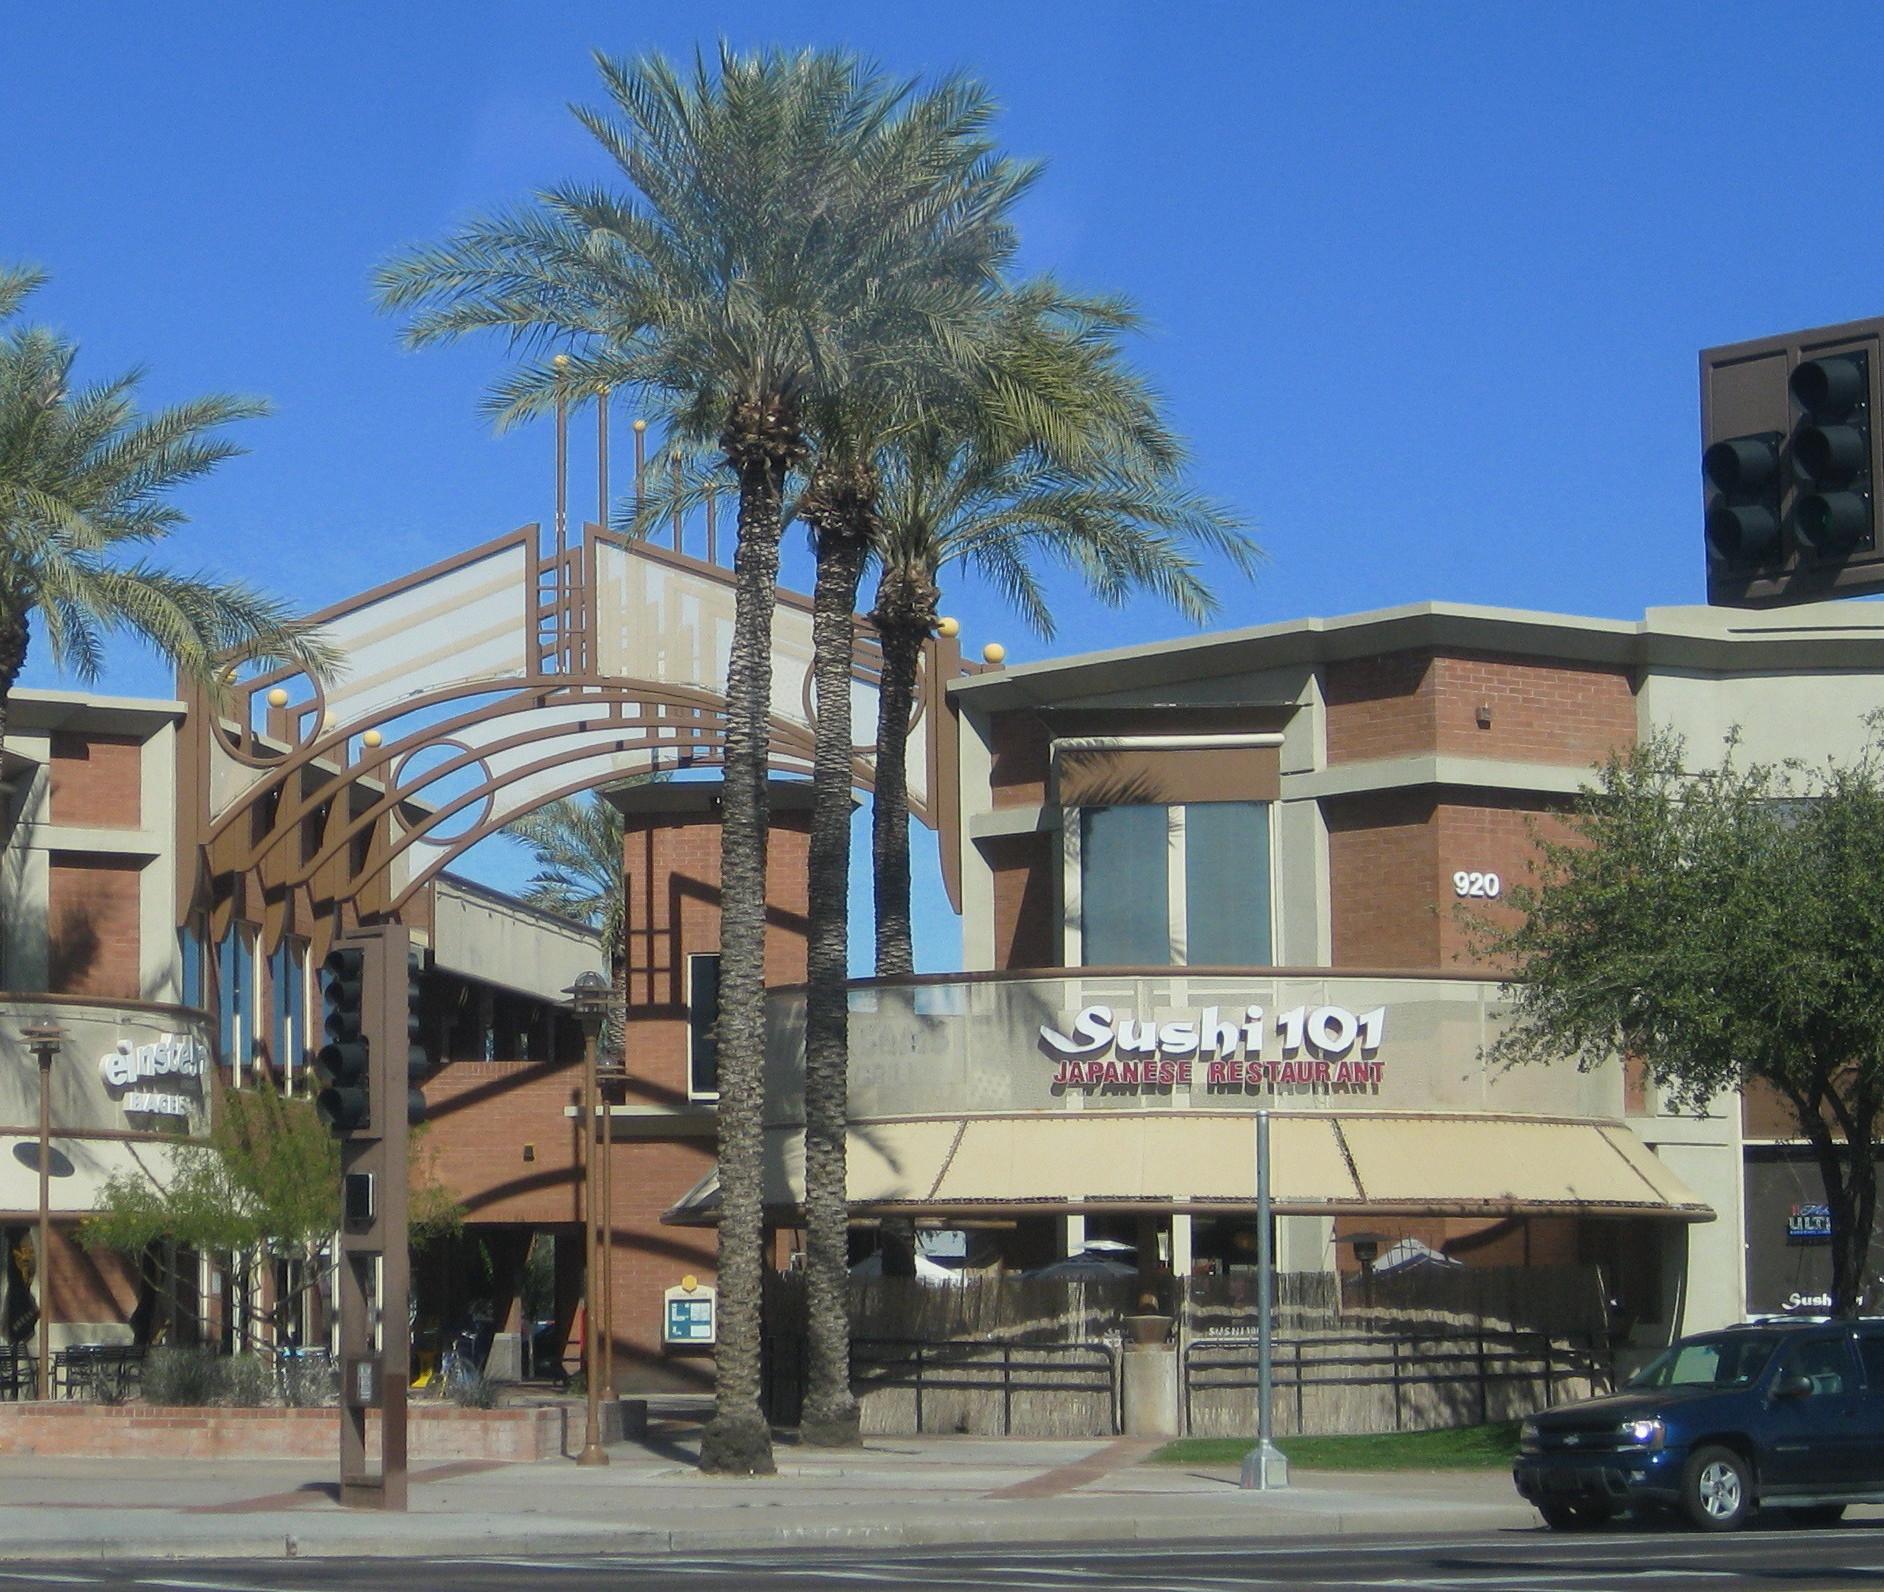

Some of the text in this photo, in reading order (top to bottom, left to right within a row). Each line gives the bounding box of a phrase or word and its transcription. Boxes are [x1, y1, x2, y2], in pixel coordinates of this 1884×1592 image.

[1453, 871, 1500, 897] 920
[1040, 1005, 1386, 1054] Sushi 101
[1054, 1060, 1385, 1084] JAPANESE RESTAURANT
[1789, 1216, 1831, 1231] ULT
[1781, 1293, 1832, 1309] Sush
